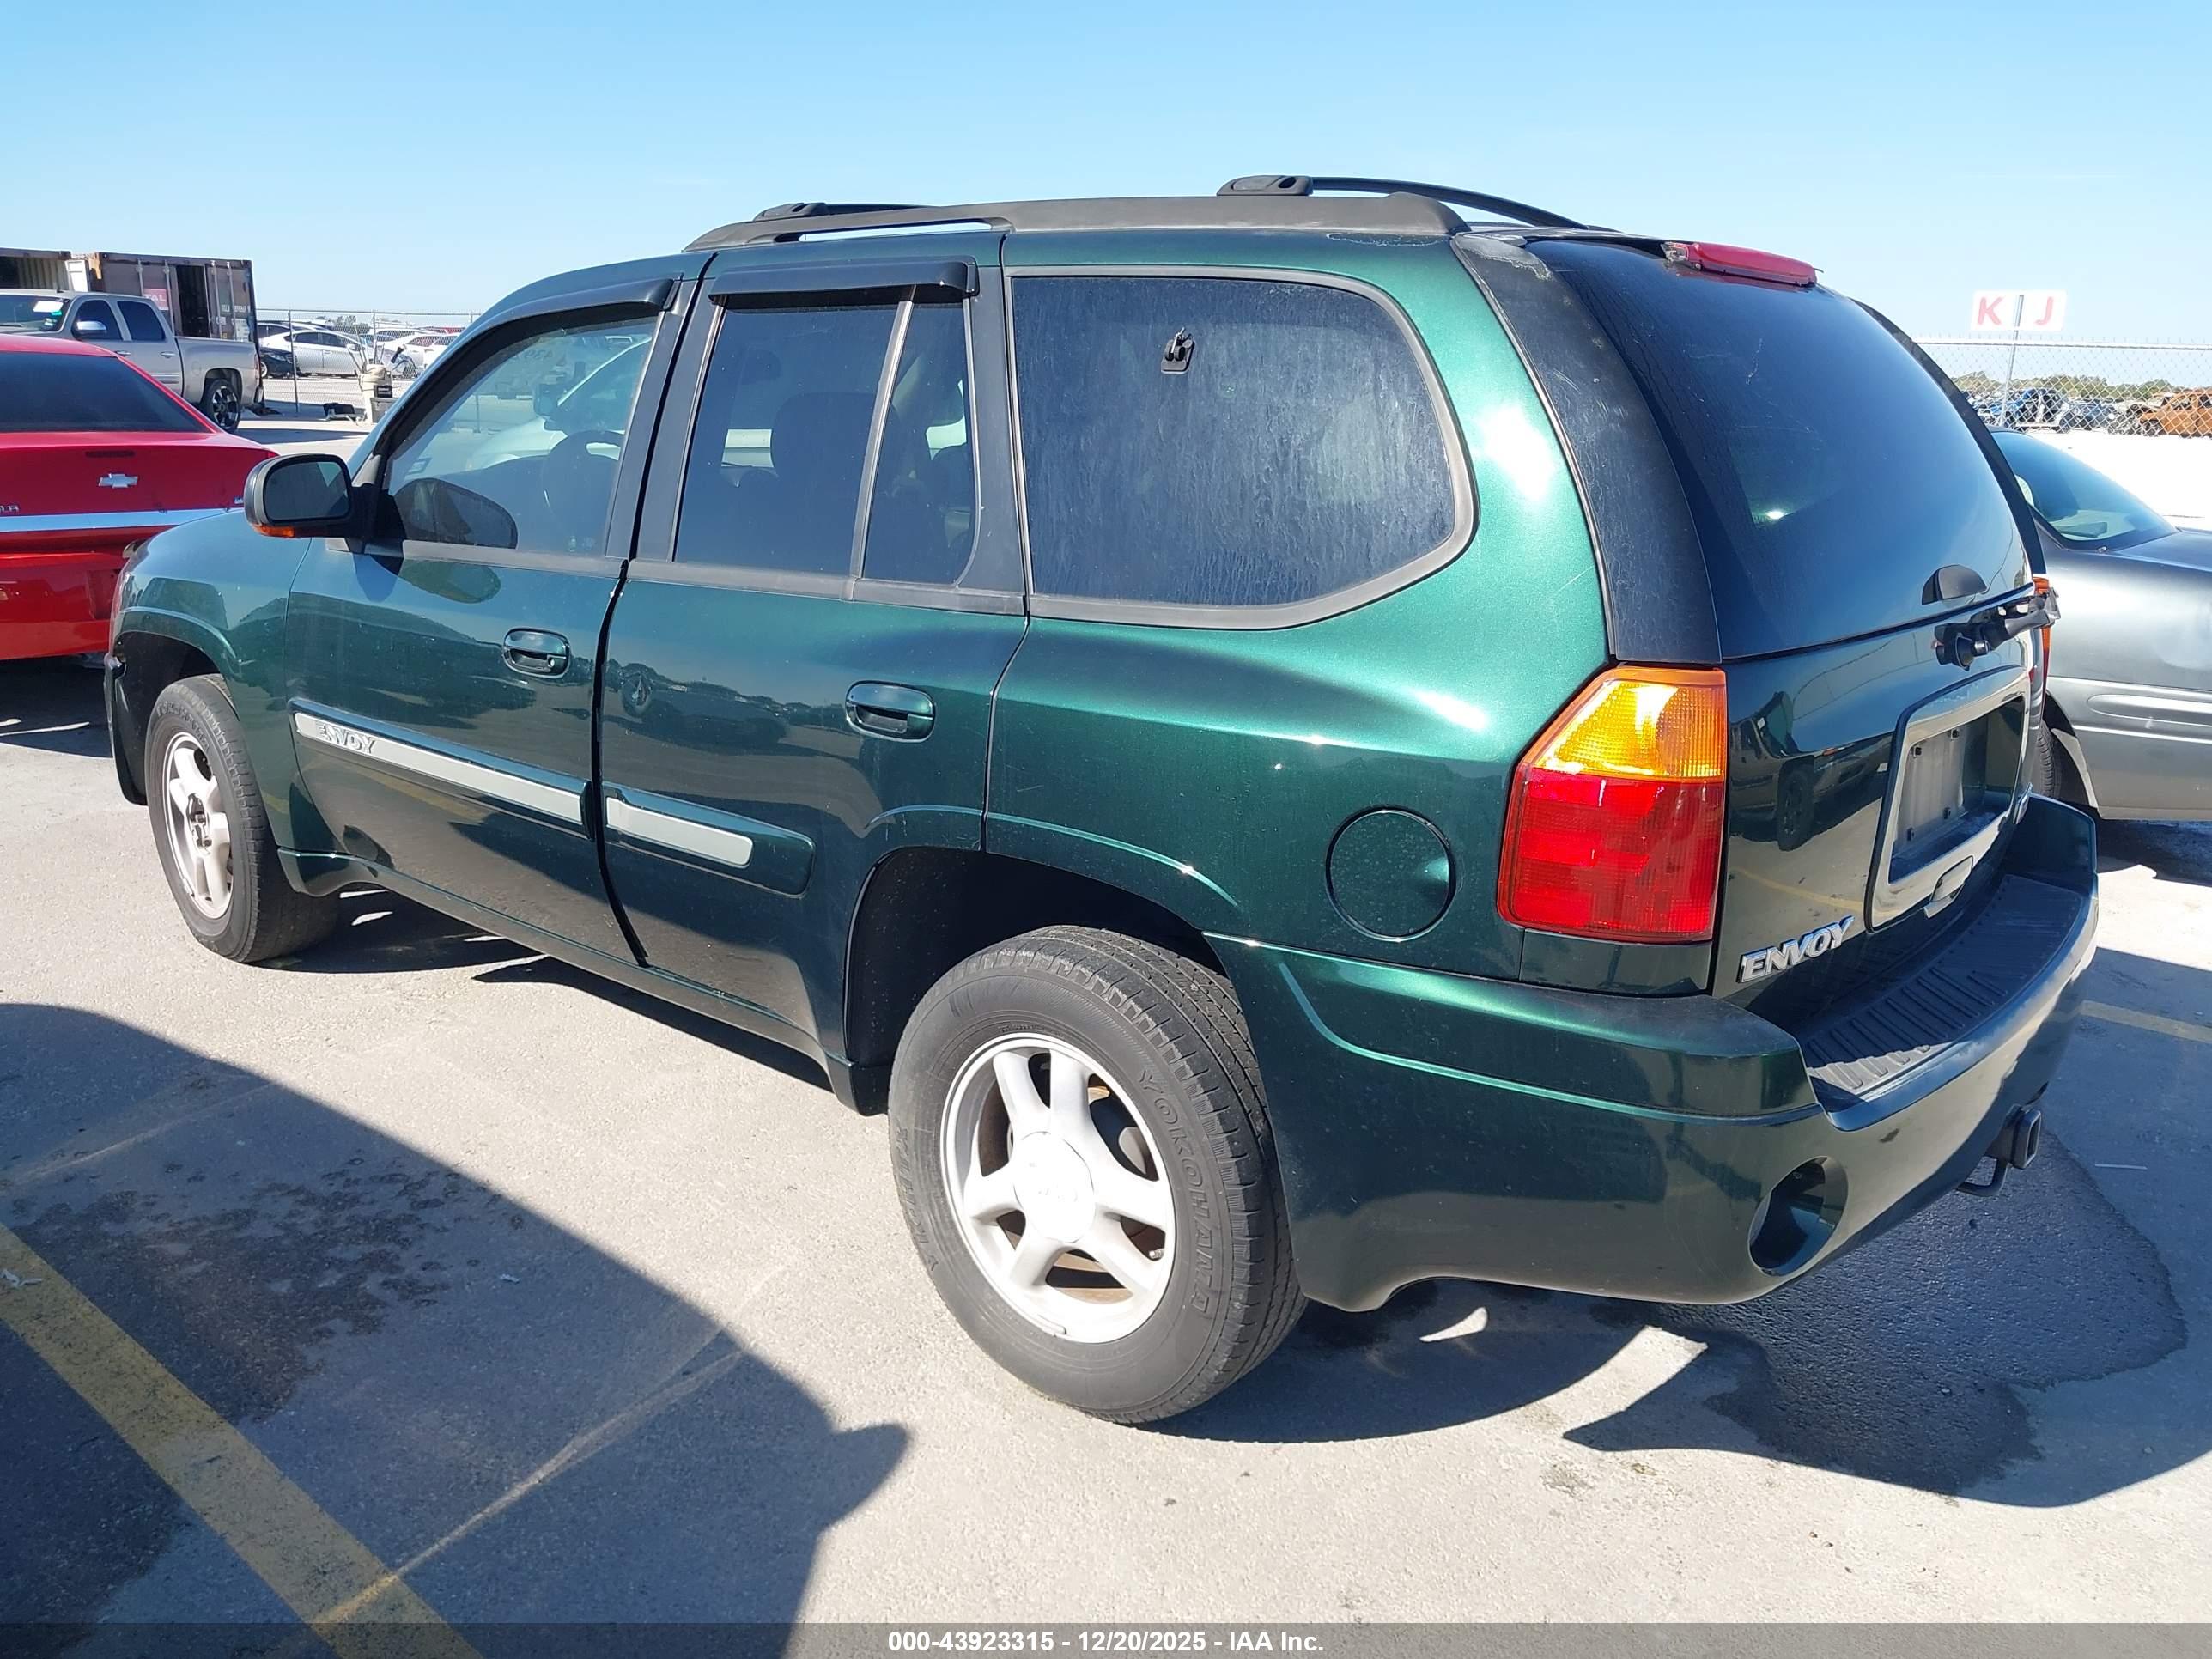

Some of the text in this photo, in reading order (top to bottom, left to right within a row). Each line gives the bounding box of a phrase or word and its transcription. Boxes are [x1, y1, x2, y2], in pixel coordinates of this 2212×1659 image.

[1978, 296, 2053, 325] K J
[318, 724, 376, 754] ENVOY
[1735, 915, 1856, 983] ENVOY
[1139, 1069, 1214, 1314] YOKOHAMA
